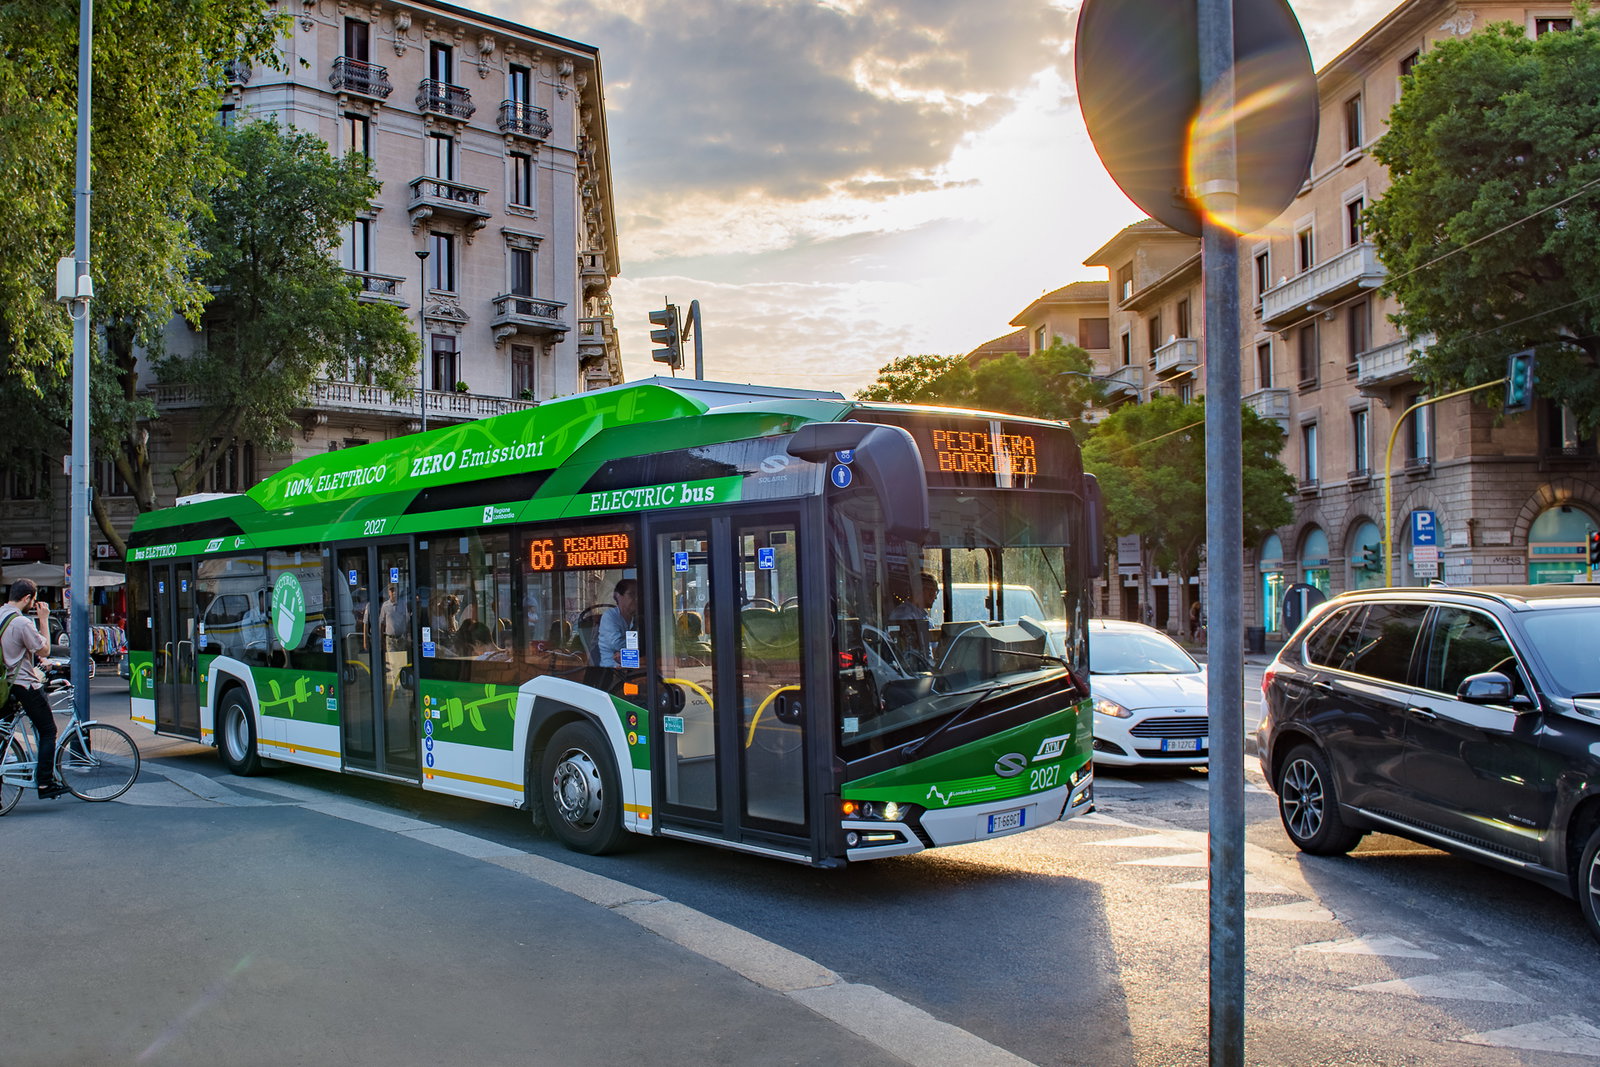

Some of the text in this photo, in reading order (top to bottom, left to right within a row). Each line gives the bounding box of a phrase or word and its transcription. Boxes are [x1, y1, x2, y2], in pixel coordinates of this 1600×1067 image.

[933, 429, 1036, 456] PESCHIERA
[410, 435, 545, 477] ZERO Emissioni
[284, 464, 387, 498] 100% ELETTRICO
[589, 483, 715, 512] ELECTRIC bus
[363, 518, 387, 535] 2027
[1417, 513, 1431, 530] P
[134, 549, 145, 560] bus
[145, 544, 177, 559] ELETTRICO
[563, 533, 629, 552] PESCHIERA
[531, 539, 554, 570] 66
[566, 549, 628, 567] BORROMEO
[1044, 741, 1060, 754] ATM
[1029, 764, 1061, 791] 2027
